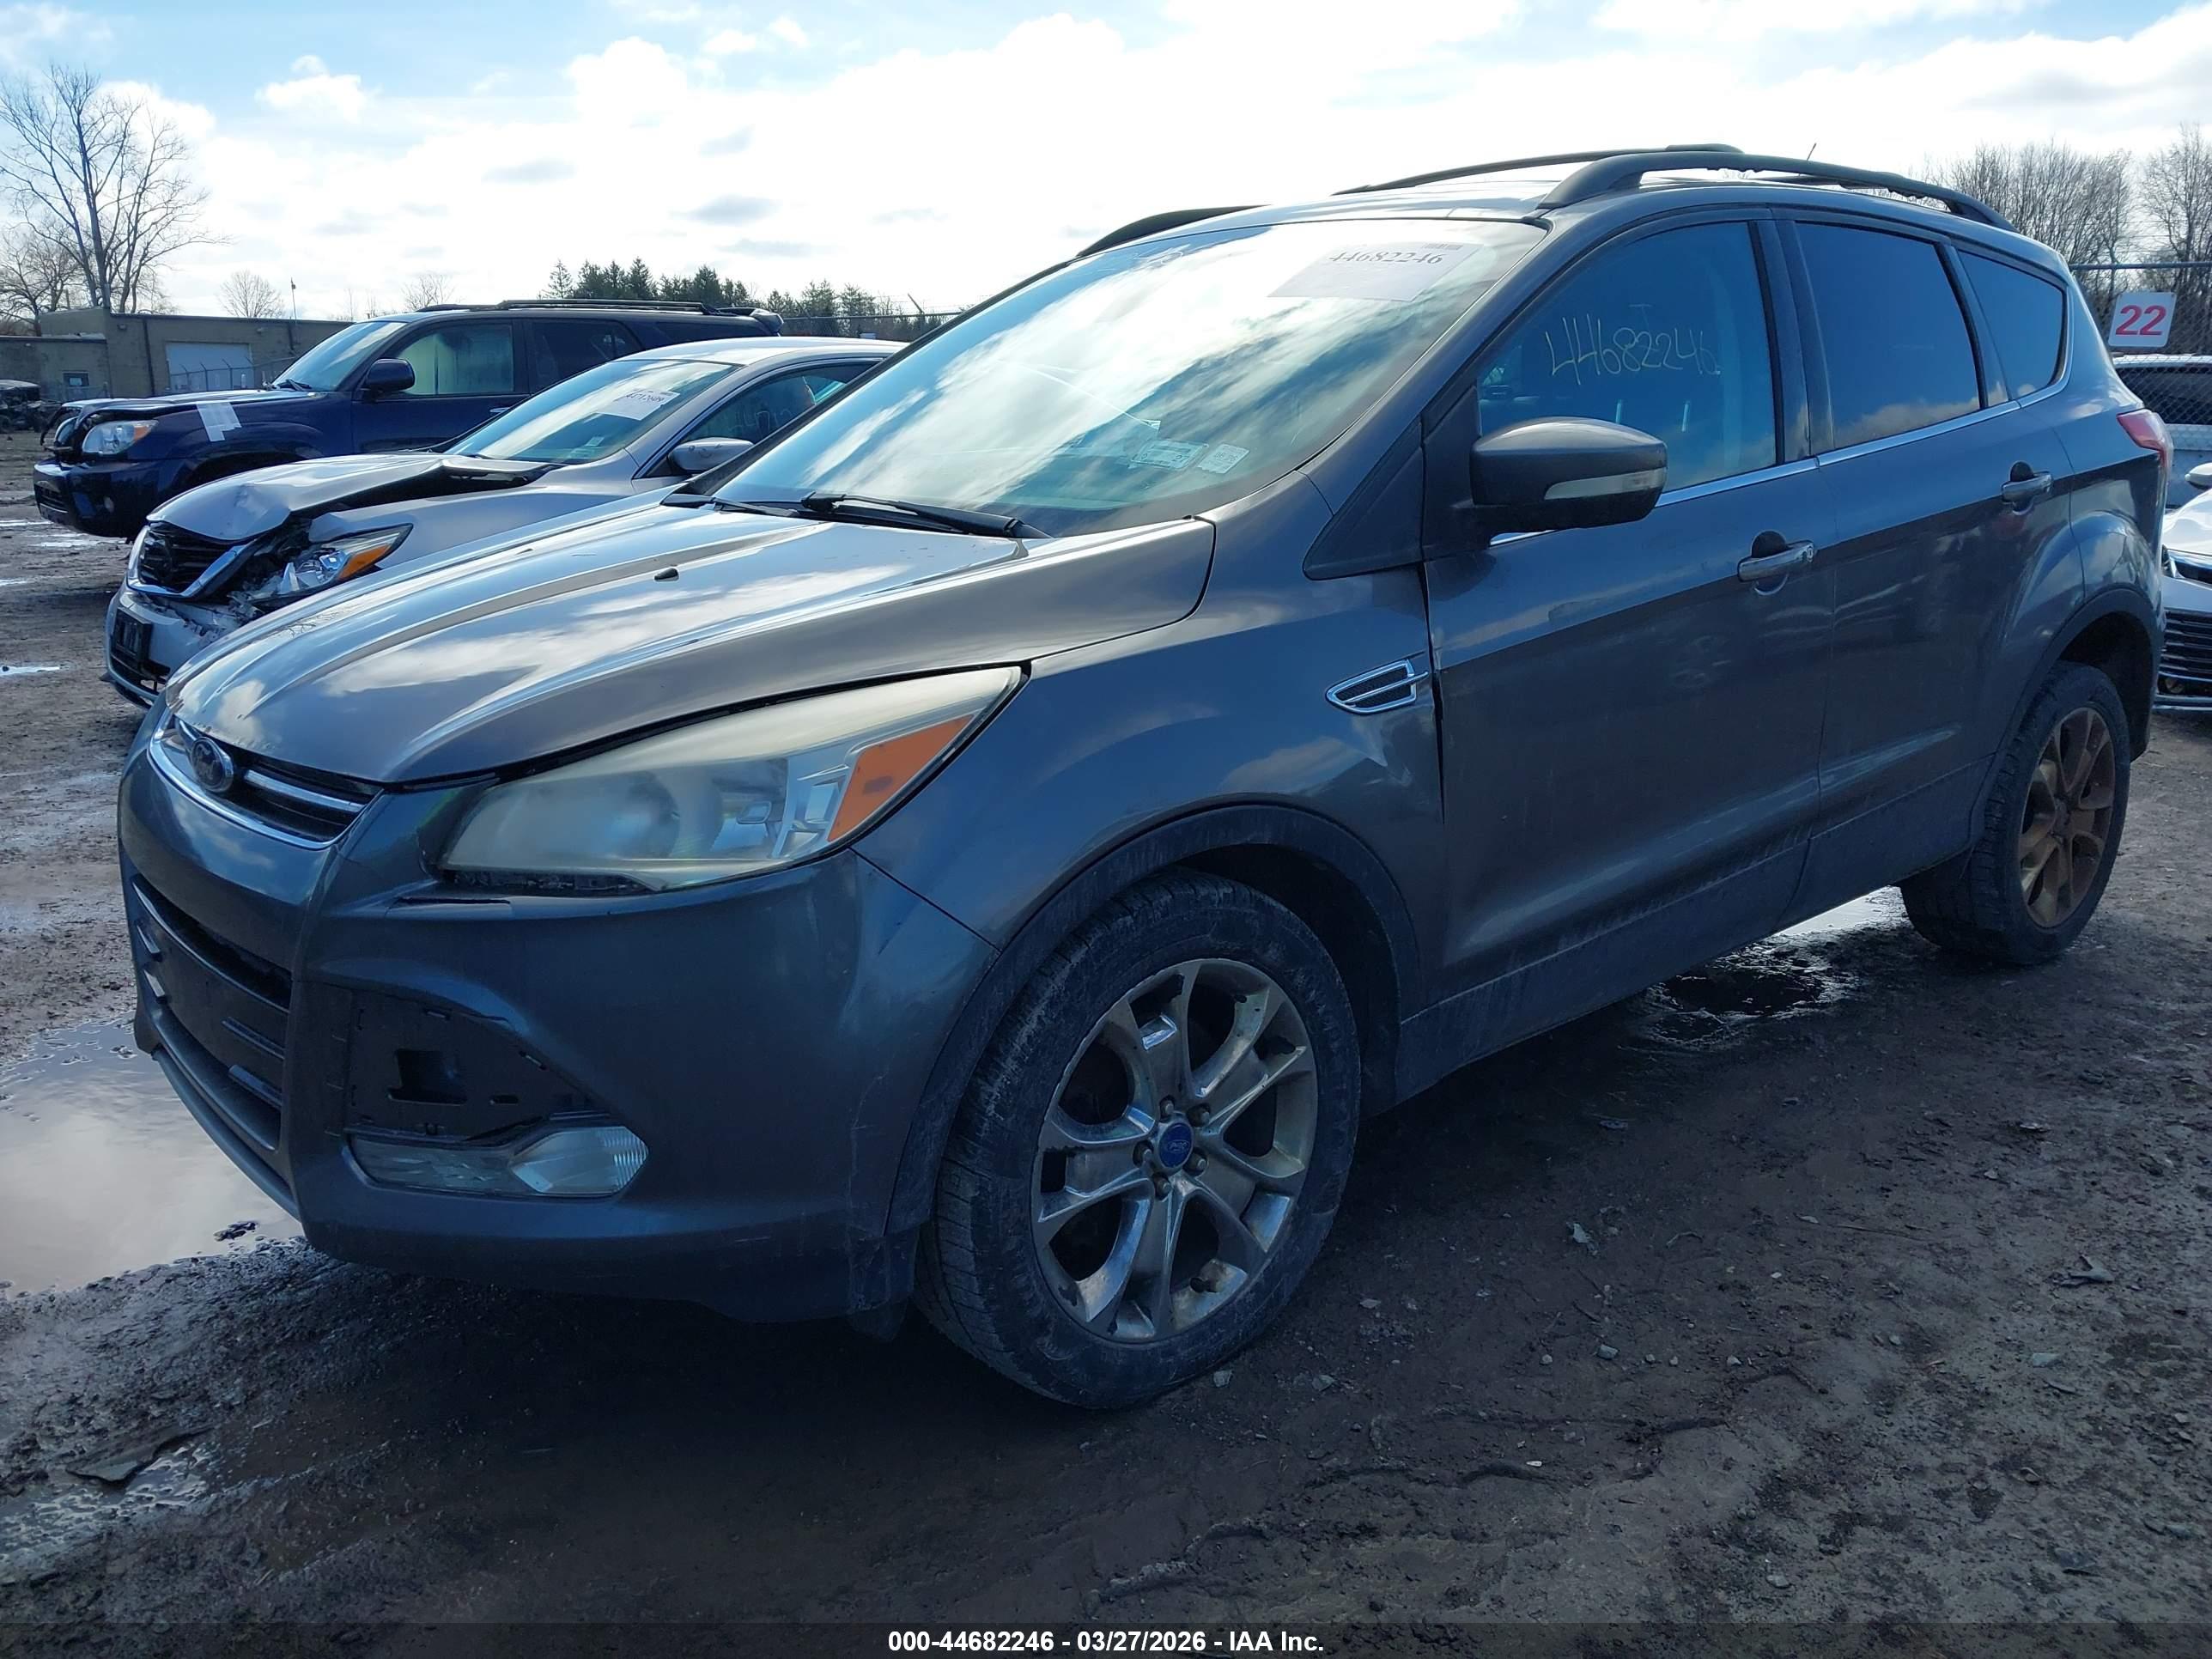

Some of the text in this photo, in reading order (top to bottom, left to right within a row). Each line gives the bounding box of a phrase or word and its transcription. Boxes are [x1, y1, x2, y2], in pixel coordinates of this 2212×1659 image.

[1328, 251, 1446, 265] 44682246
[2115, 305, 2166, 336] 22
[1546, 314, 1721, 386] 44682246
